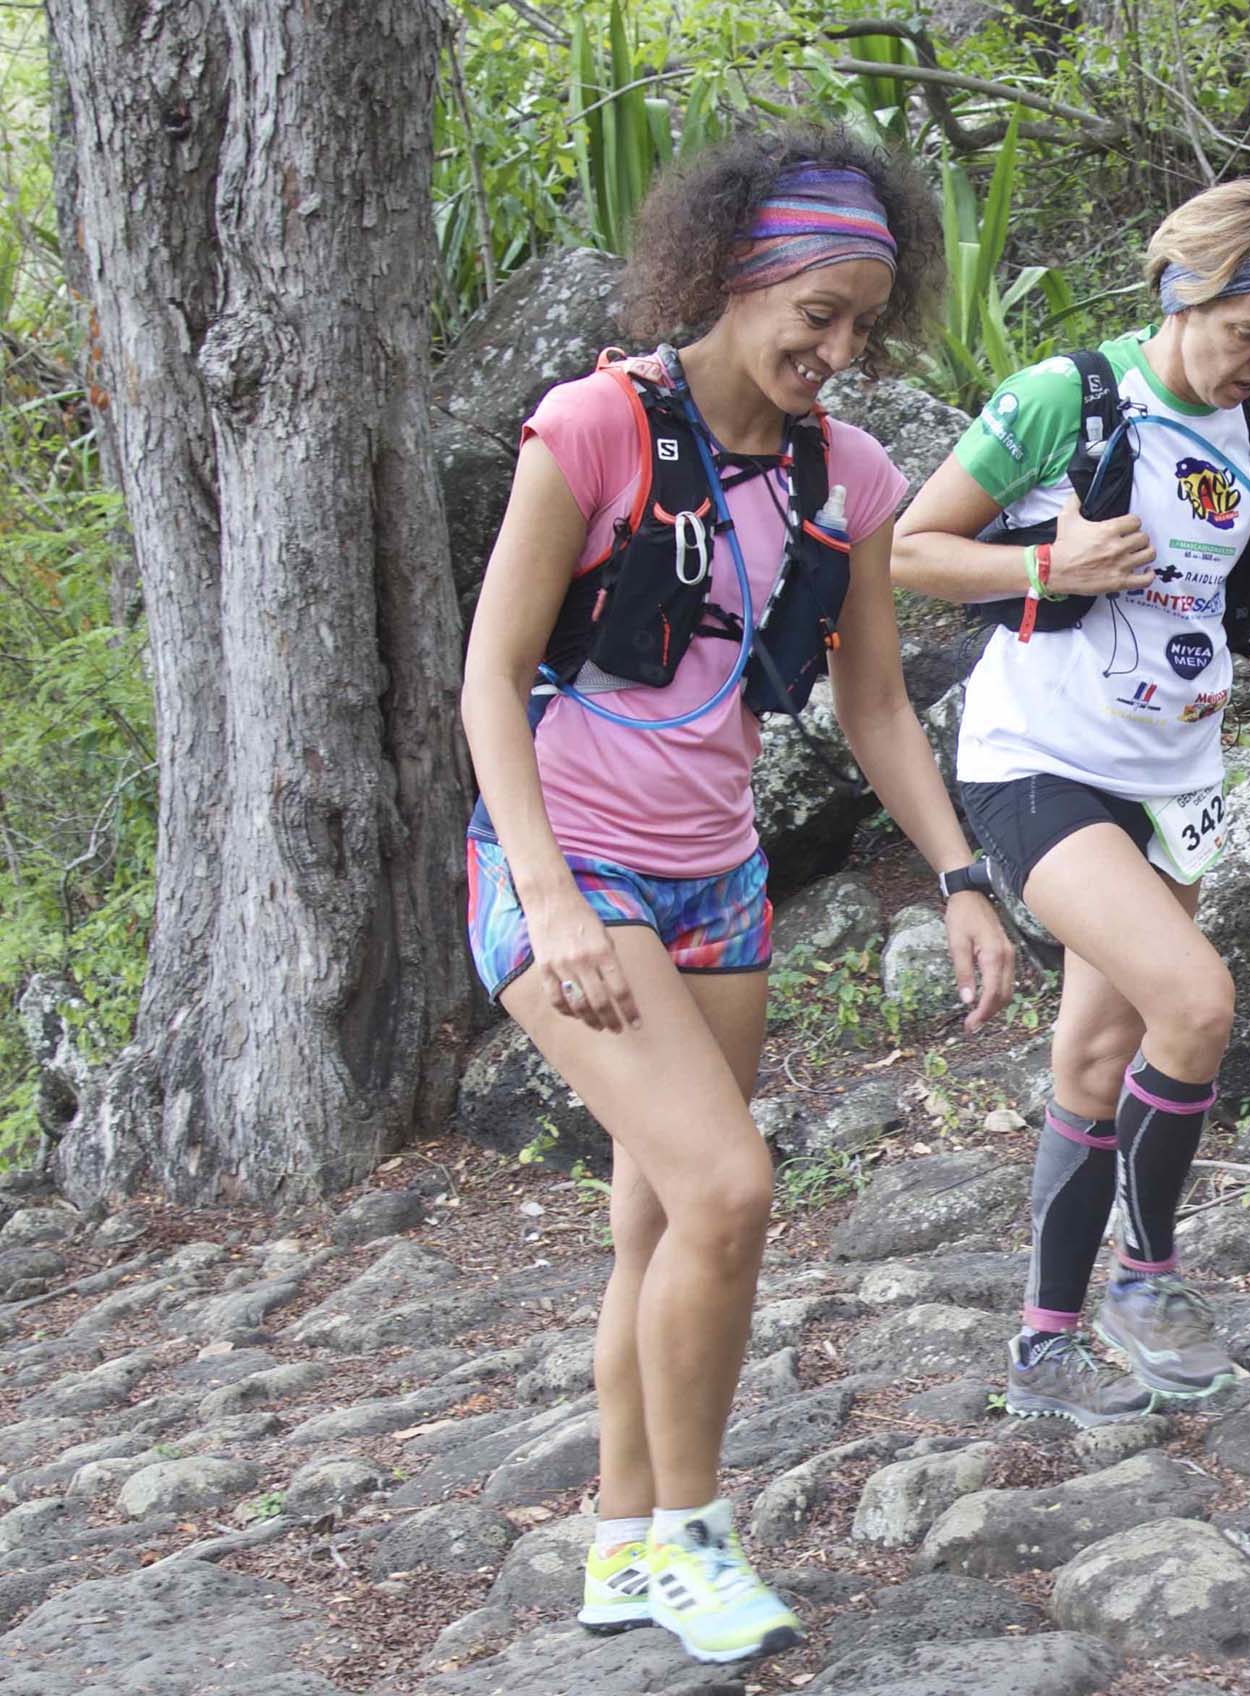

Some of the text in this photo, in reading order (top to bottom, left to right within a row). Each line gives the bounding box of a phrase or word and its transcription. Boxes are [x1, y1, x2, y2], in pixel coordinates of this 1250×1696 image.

[659, 440, 677, 459] S
[1171, 643, 1212, 657] NIVEA
[1174, 655, 1207, 667] MEN
[1182, 795, 1225, 851] 342
